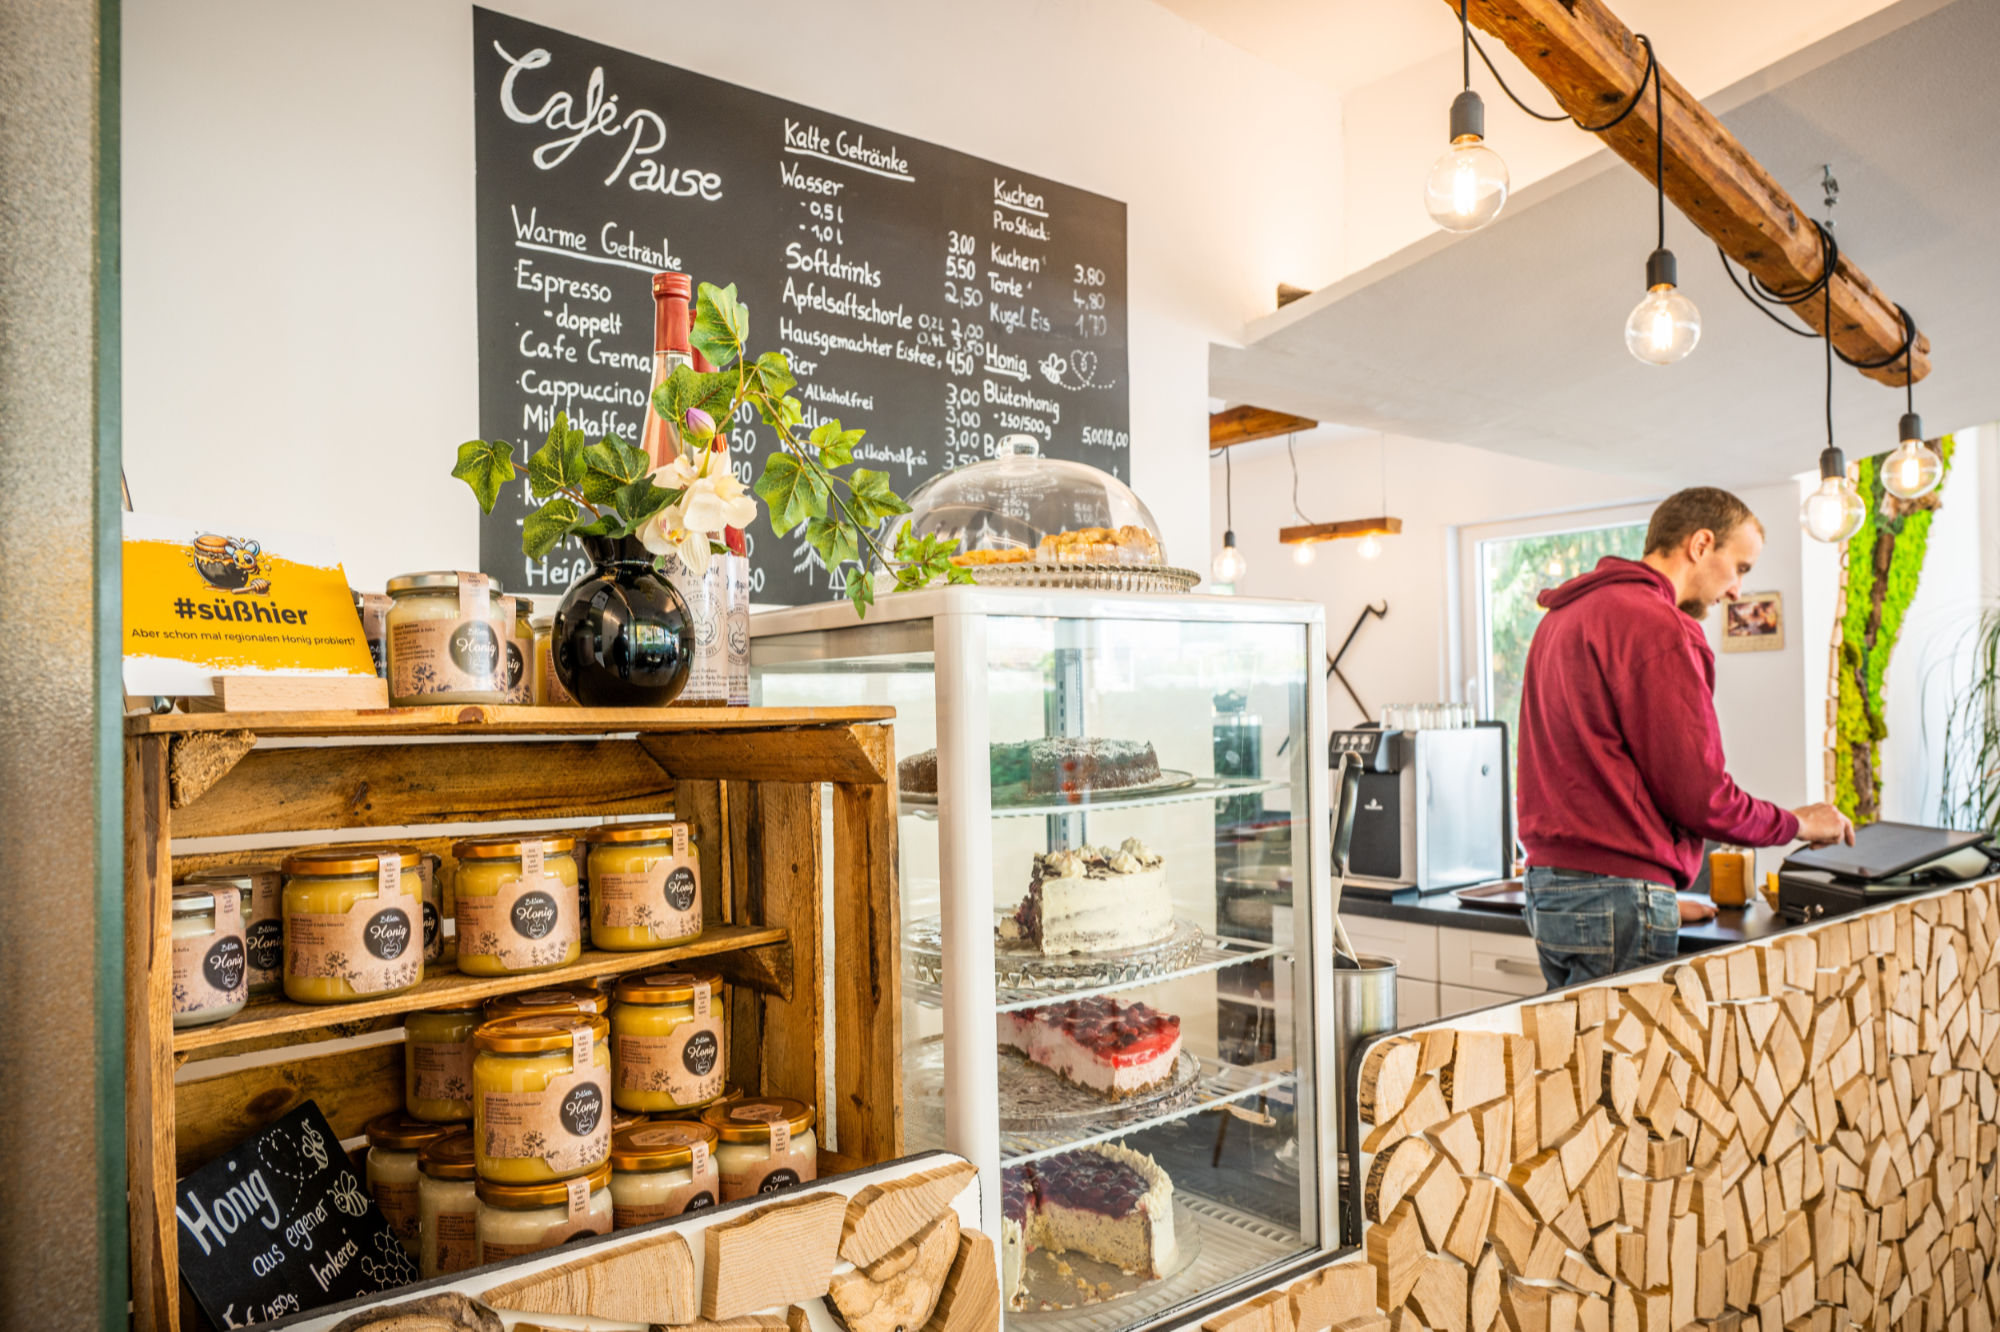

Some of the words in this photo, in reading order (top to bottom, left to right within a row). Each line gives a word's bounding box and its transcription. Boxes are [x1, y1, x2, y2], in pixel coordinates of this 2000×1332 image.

[604, 109, 723, 201] Pause
[785, 118, 830, 154] Kalte
[836, 130, 909, 173] Getränke
[780, 160, 844, 196] Wasser
[994, 177, 1044, 210] Kuchen
[512, 204, 587, 251] Warme
[601, 222, 682, 271] Getränke
[786, 242, 881, 288] Softdrinks
[990, 242, 1040, 273] Kuchen
[517, 258, 612, 303] Espresso
[988, 271, 1023, 298] Torte
[782, 276, 913, 329] Apfelsaftschorle
[990, 301, 1026, 334] Kugel
[1030, 308, 1051, 332] Eis
[520, 330, 578, 363] Cafe
[587, 339, 651, 374] Crema
[780, 316, 893, 357] Hausgemachter
[780, 348, 817, 376] Bier
[986, 342, 1029, 381] Honig
[521, 370, 646, 407] Cappuccino
[983, 379, 1060, 424] Blütenhonig
[523, 404, 638, 440] Milhkaffee
[173, 597, 308, 625] #süßhier
[131, 628, 160, 639] Aber
[163, 629, 198, 641] schon
[201, 631, 222, 641] mal
[224, 632, 280, 644] regionalen
[282, 635, 312, 646] Honig
[313, 635, 356, 646] probiert?
[516, 906, 555, 921] Honig
[370, 925, 408, 941] Honig
[209, 954, 243, 970] Honig
[687, 1044, 716, 1060] Honig
[565, 1098, 600, 1117] Honig
[175, 1160, 280, 1257] Honig
[252, 1243, 286, 1277] aus
[285, 1198, 330, 1251] eigener
[309, 1227, 359, 1293] Imkerei
